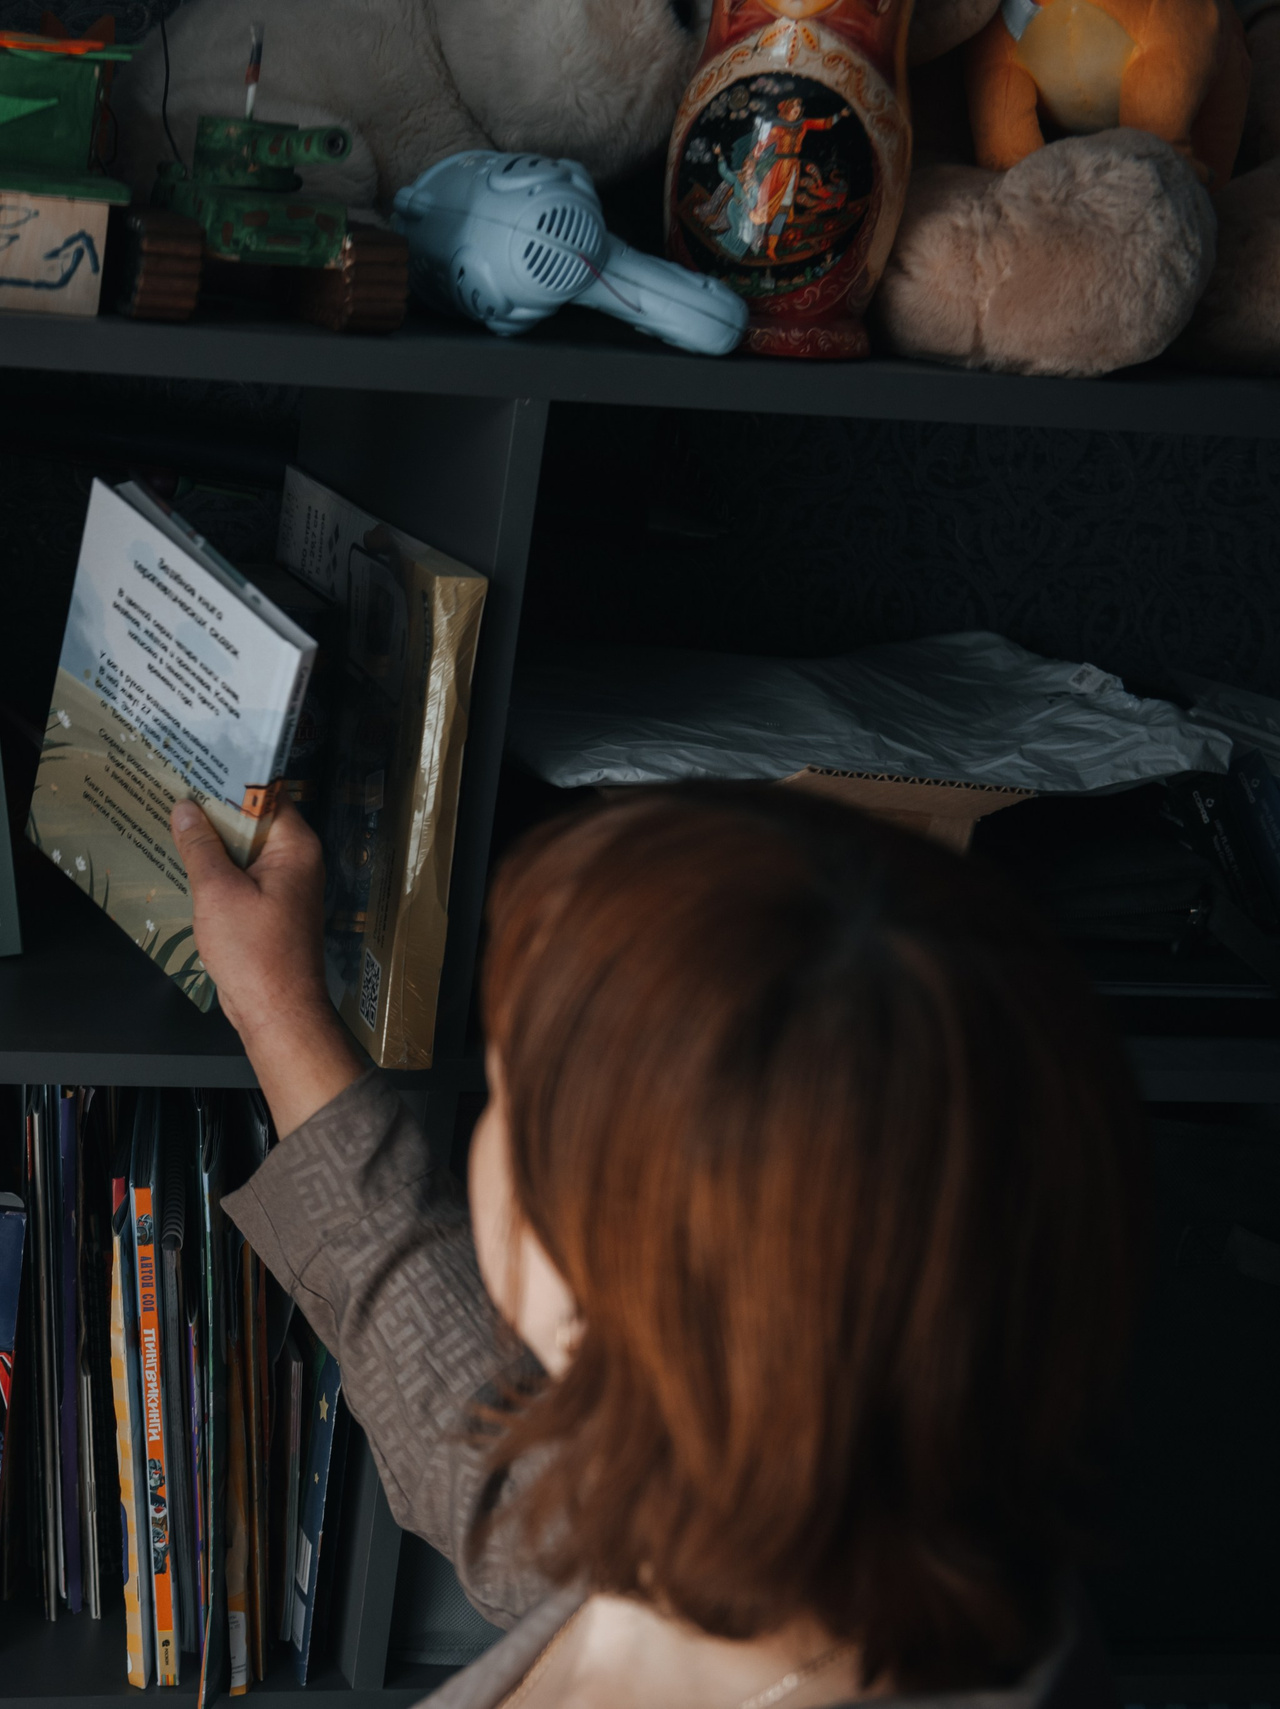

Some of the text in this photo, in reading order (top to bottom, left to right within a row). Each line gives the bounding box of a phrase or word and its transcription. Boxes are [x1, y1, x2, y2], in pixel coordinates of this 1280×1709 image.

[139, 1255, 155, 1312] АНТОН СОЯ
[142, 1327, 161, 1442] ПИНГВИКИНГИ
